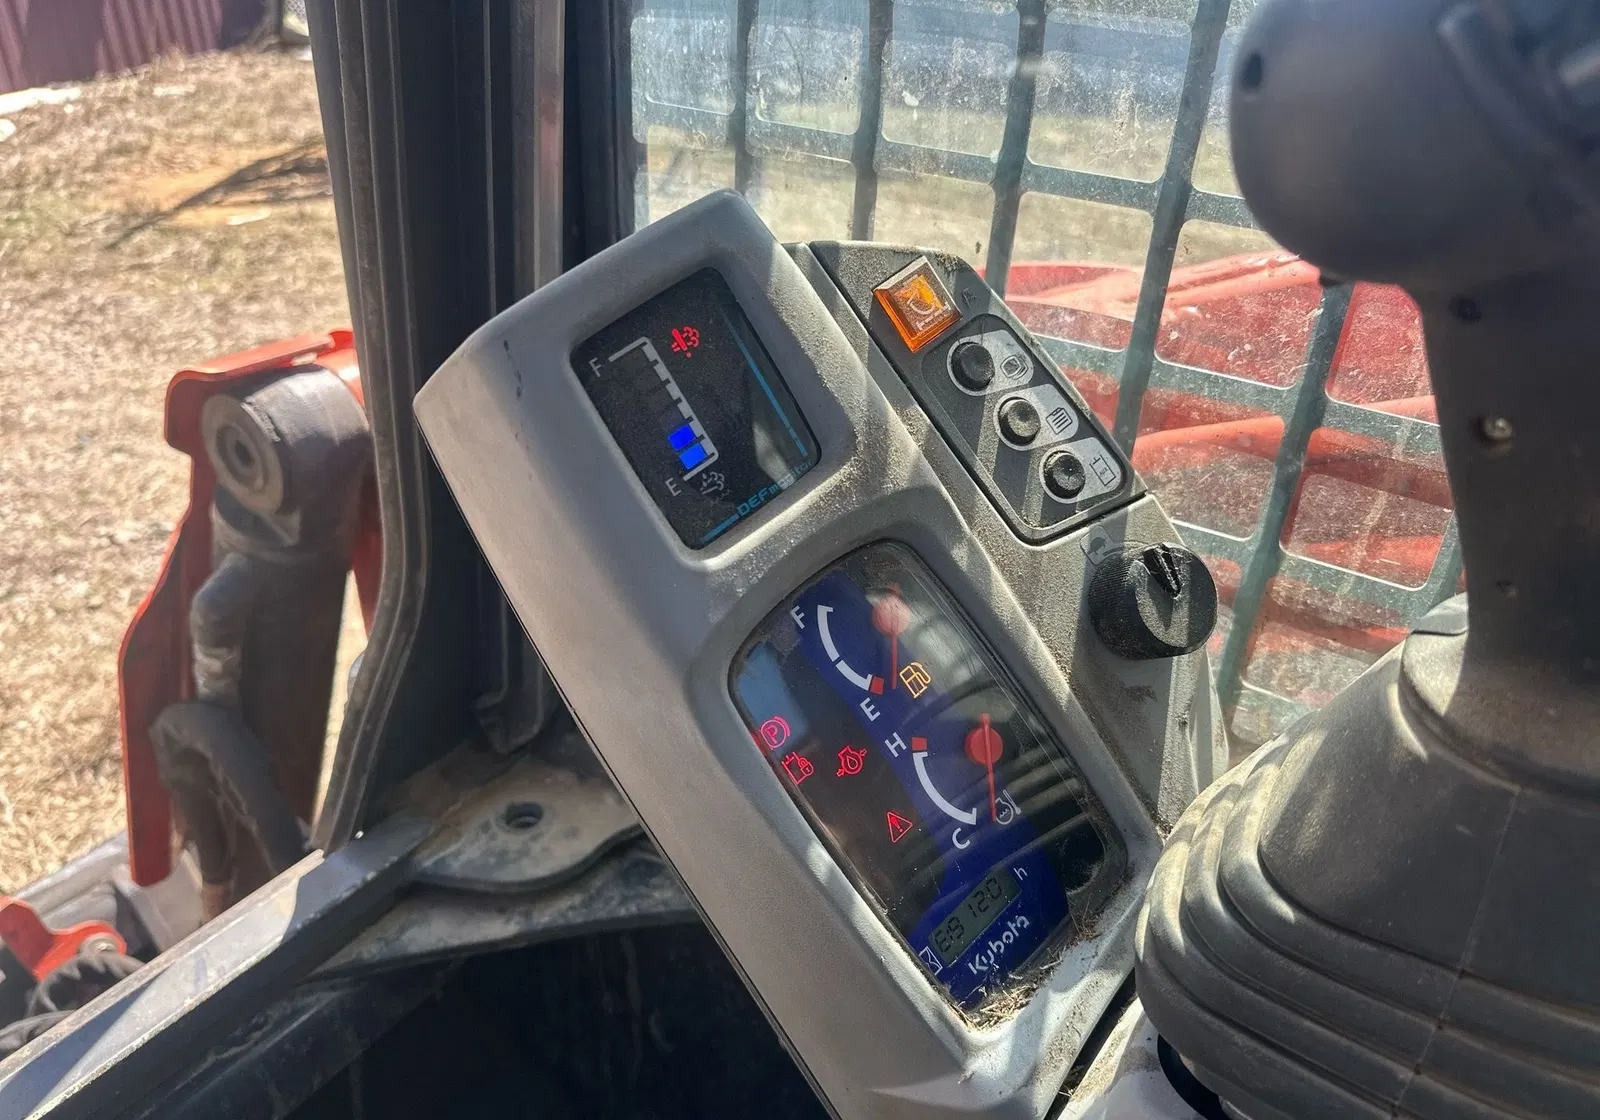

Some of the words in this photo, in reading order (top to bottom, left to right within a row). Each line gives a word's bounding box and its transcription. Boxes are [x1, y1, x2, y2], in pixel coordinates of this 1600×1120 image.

[588, 357, 602, 378] F
[664, 477, 682, 497] E
[789, 605, 806, 630] F
[859, 697, 881, 722] E
[884, 731, 907, 758] H
[951, 827, 971, 850] C
[1013, 866, 1029, 882] h
[967, 914, 1031, 975] Kubota
